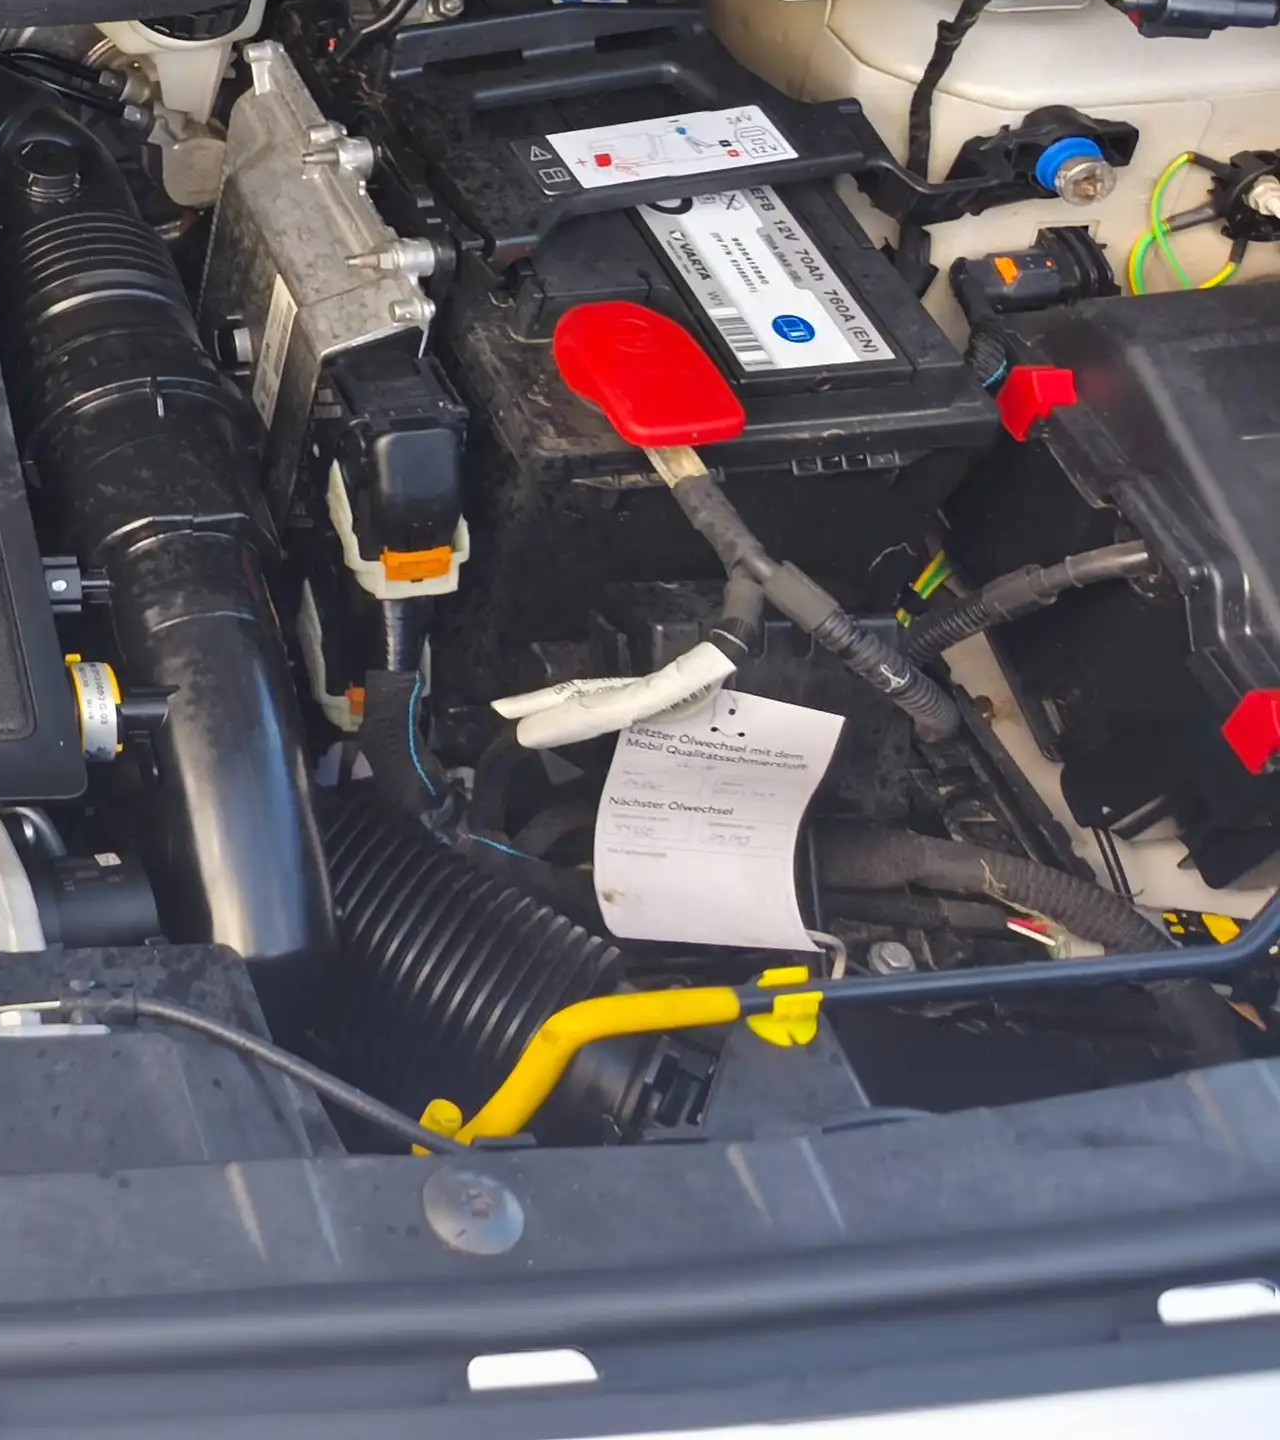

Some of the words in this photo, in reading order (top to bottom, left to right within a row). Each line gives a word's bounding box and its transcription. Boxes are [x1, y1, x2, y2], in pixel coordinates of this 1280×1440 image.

[751, 144, 778, 154] 12V
[680, 242, 714, 281] VARTA
[750, 187, 776, 212] EFB
[773, 219, 800, 242] 12V
[794, 248, 826, 283] 70Ah
[823, 288, 857, 323] 760A
[846, 325, 880, 354] (EN)
[626, 737, 664, 752] Mobil
[629, 725, 676, 741] Letzter
[679, 733, 747, 753] Ölwechsel
[749, 746, 773, 757] mit
[774, 749, 805, 761] dem
[609, 796, 666, 810] Nächster
[668, 800, 735, 816] Ölwechsel
